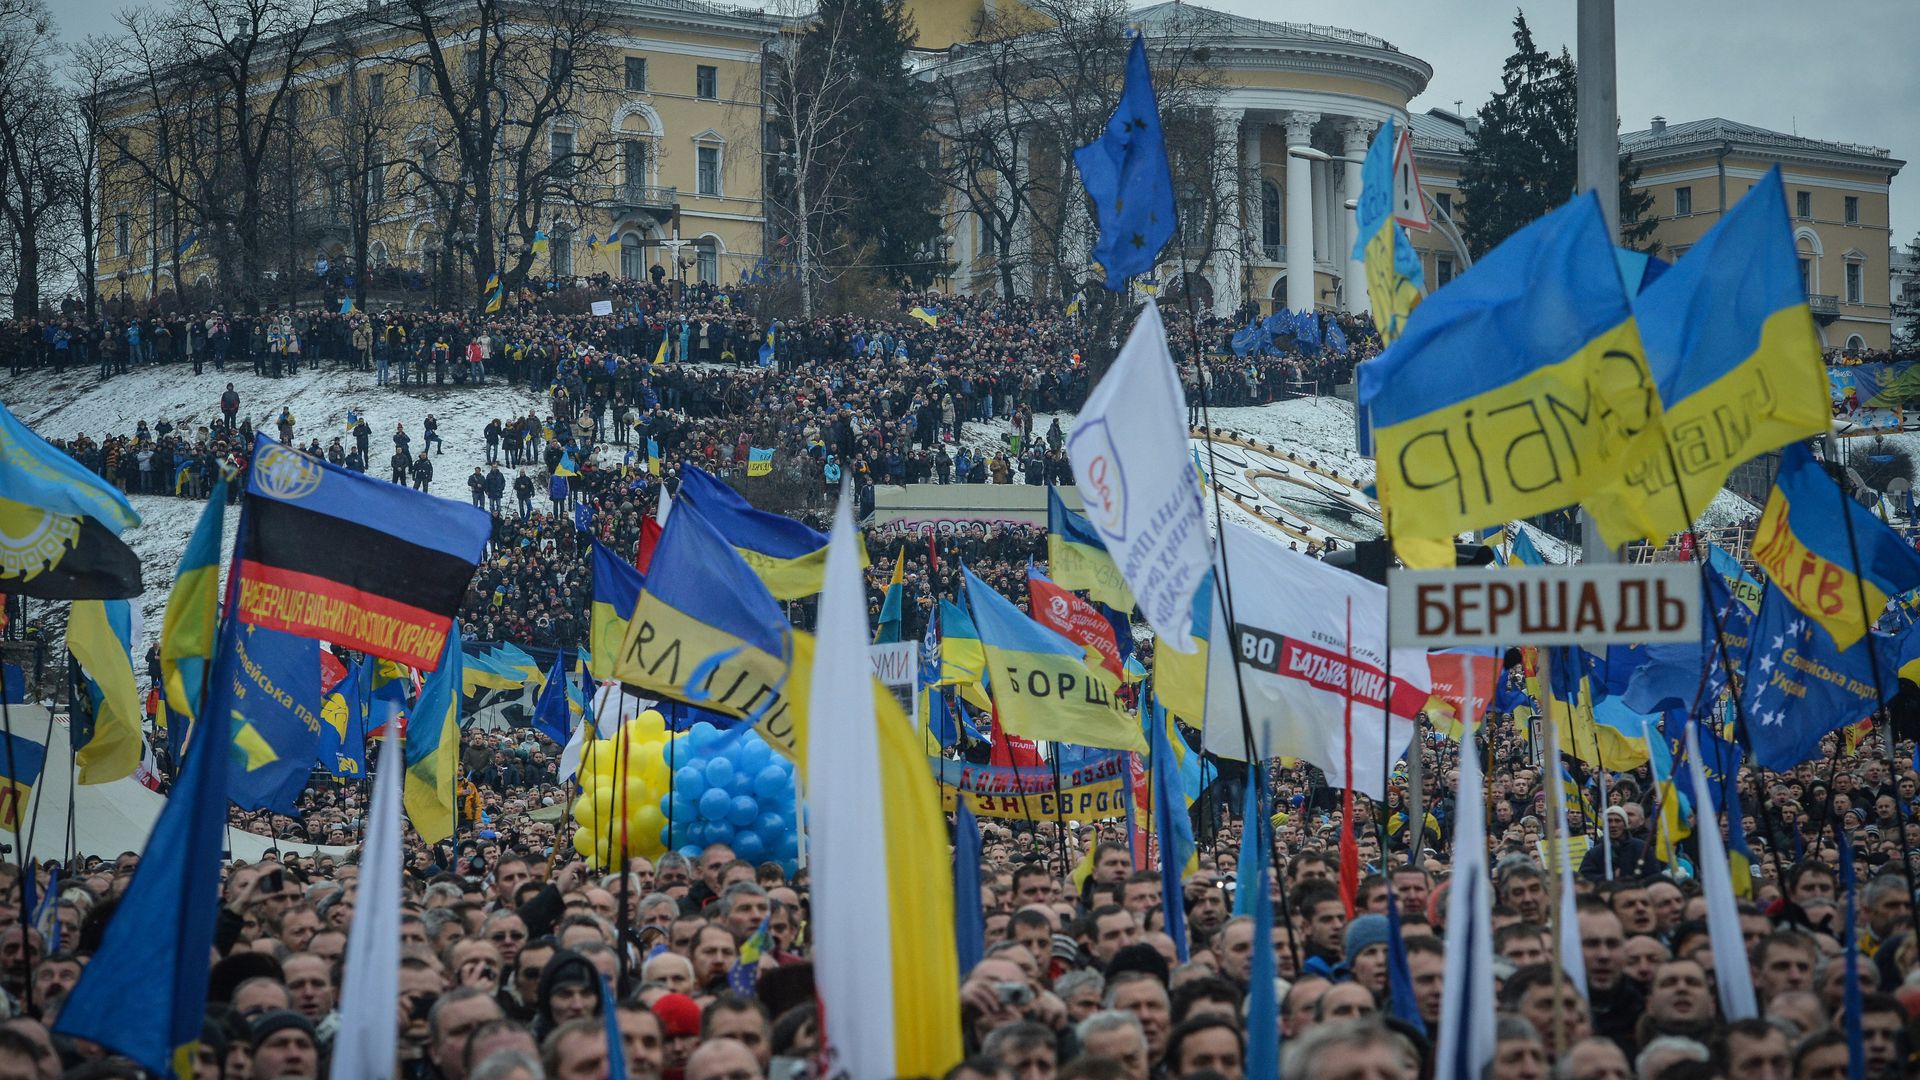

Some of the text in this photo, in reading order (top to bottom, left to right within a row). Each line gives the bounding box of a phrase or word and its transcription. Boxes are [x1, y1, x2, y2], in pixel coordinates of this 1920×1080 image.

[1416, 580, 1687, 637] БЕРШАДЬ
[304, 593, 348, 634] ВІЛЬНИХ
[395, 622, 446, 662] УКРАЇНИ
[1241, 632, 1275, 664] ВО
[871, 650, 909, 680] УМИ
[1041, 788, 1124, 815] ЄВРОП
